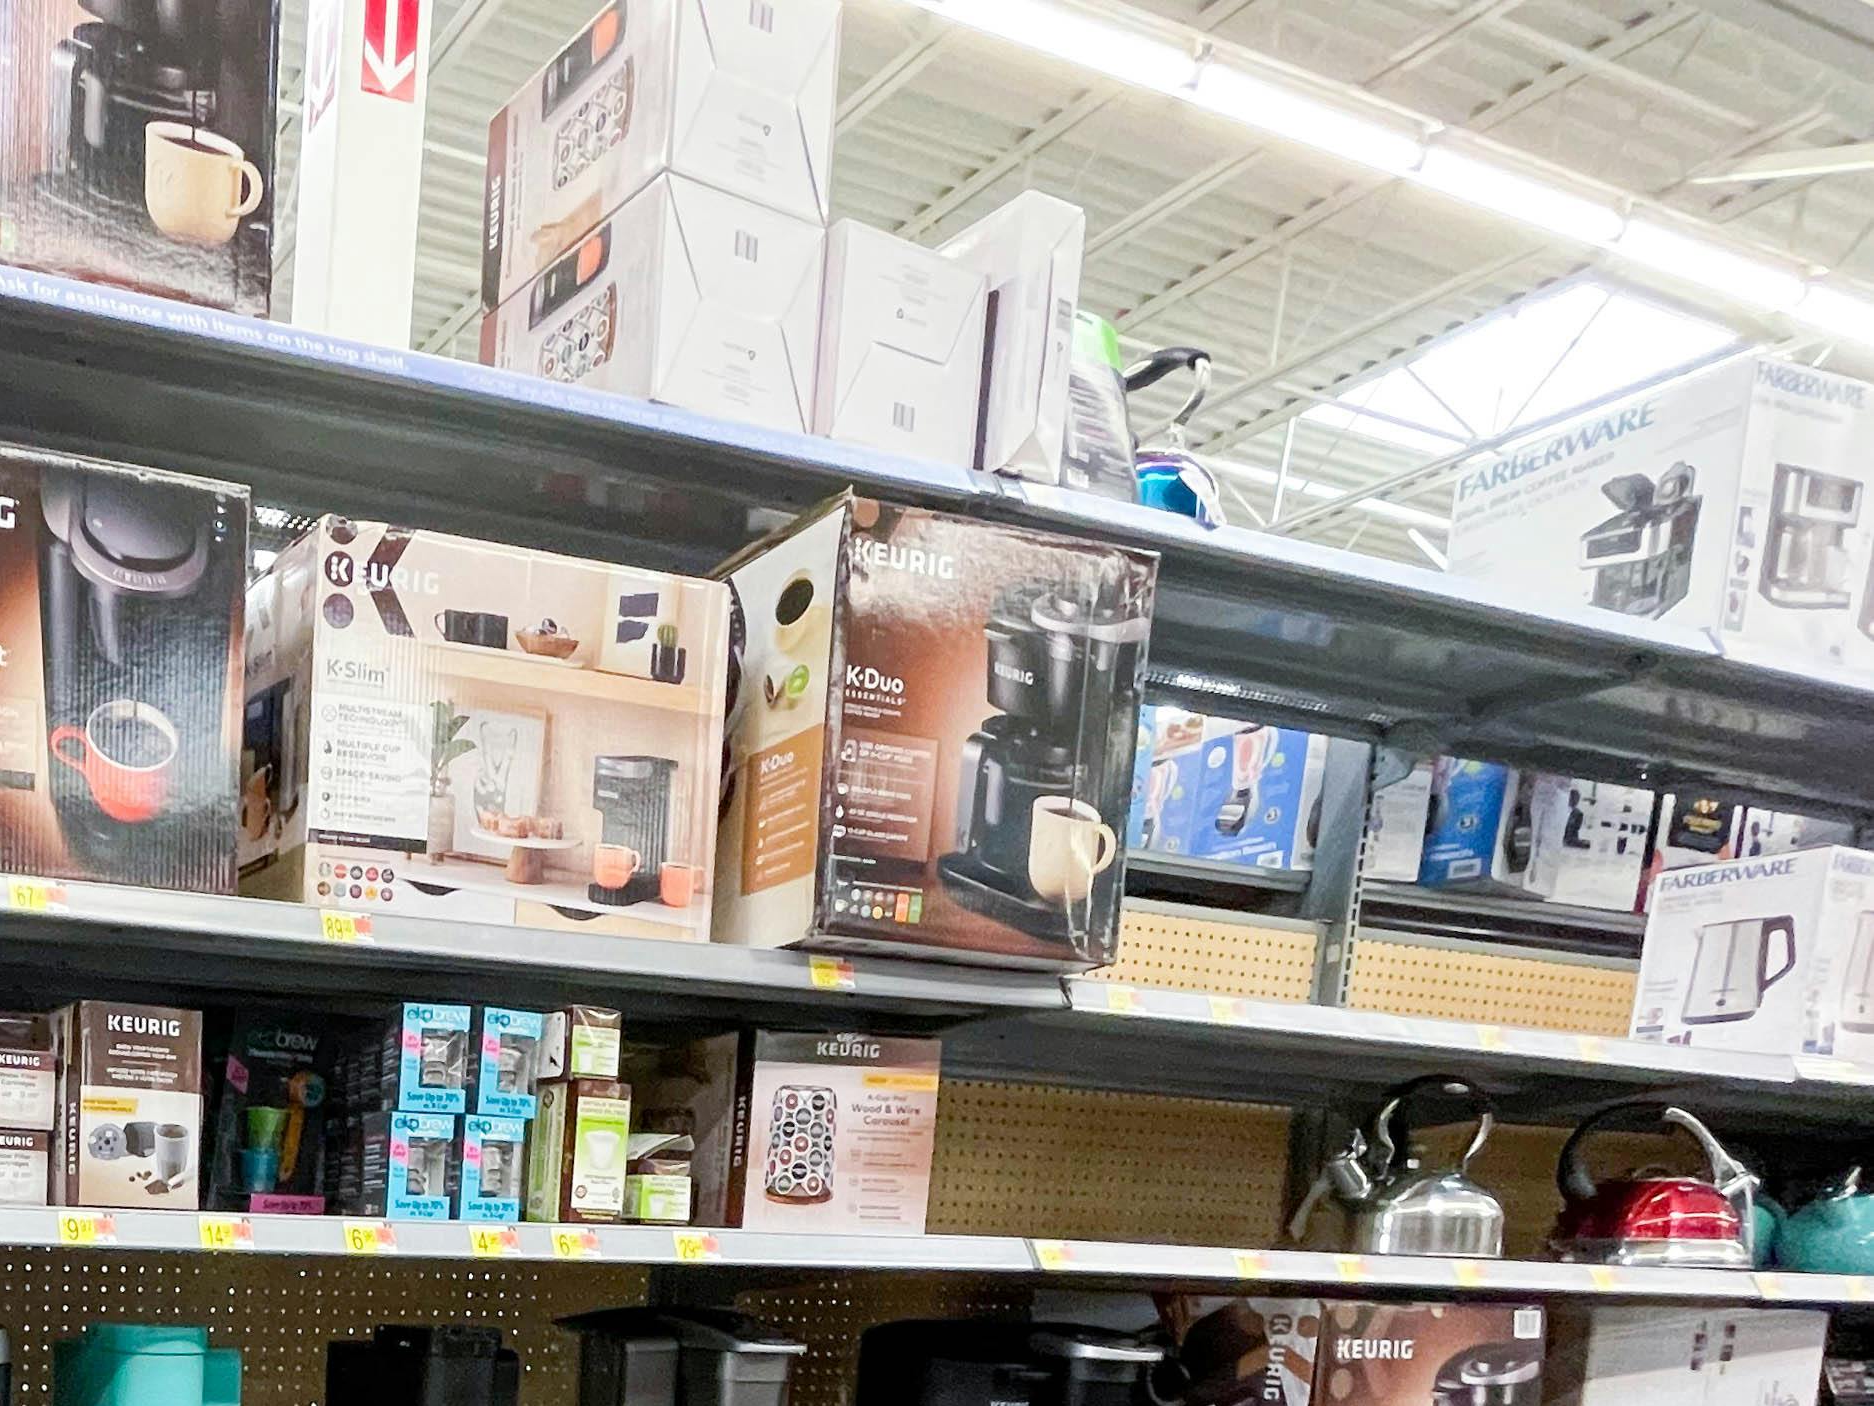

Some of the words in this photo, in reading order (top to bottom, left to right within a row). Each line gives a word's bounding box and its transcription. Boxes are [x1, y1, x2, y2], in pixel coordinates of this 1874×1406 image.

[487, 173, 502, 252] KEURIG
[33, 277, 60, 298] for
[65, 289, 162, 321] assistance
[168, 308, 210, 331] with
[213, 316, 263, 342] items
[268, 332, 291, 348] on
[295, 335, 325, 356] the
[329, 344, 359, 363] top
[364, 350, 409, 372] shelf.
[1459, 400, 1655, 501] FARBERWARE
[854, 537, 955, 580] KEURIG
[1660, 857, 1798, 892] FARBERWARE
[107, 1014, 182, 1037] KEURIG
[817, 1041, 881, 1058] KEURIG
[852, 1103, 883, 1115] Wood
[896, 1106, 921, 1116] Wire
[863, 1115, 911, 1127] Carousel
[1337, 1338, 1414, 1360] KEURIG
